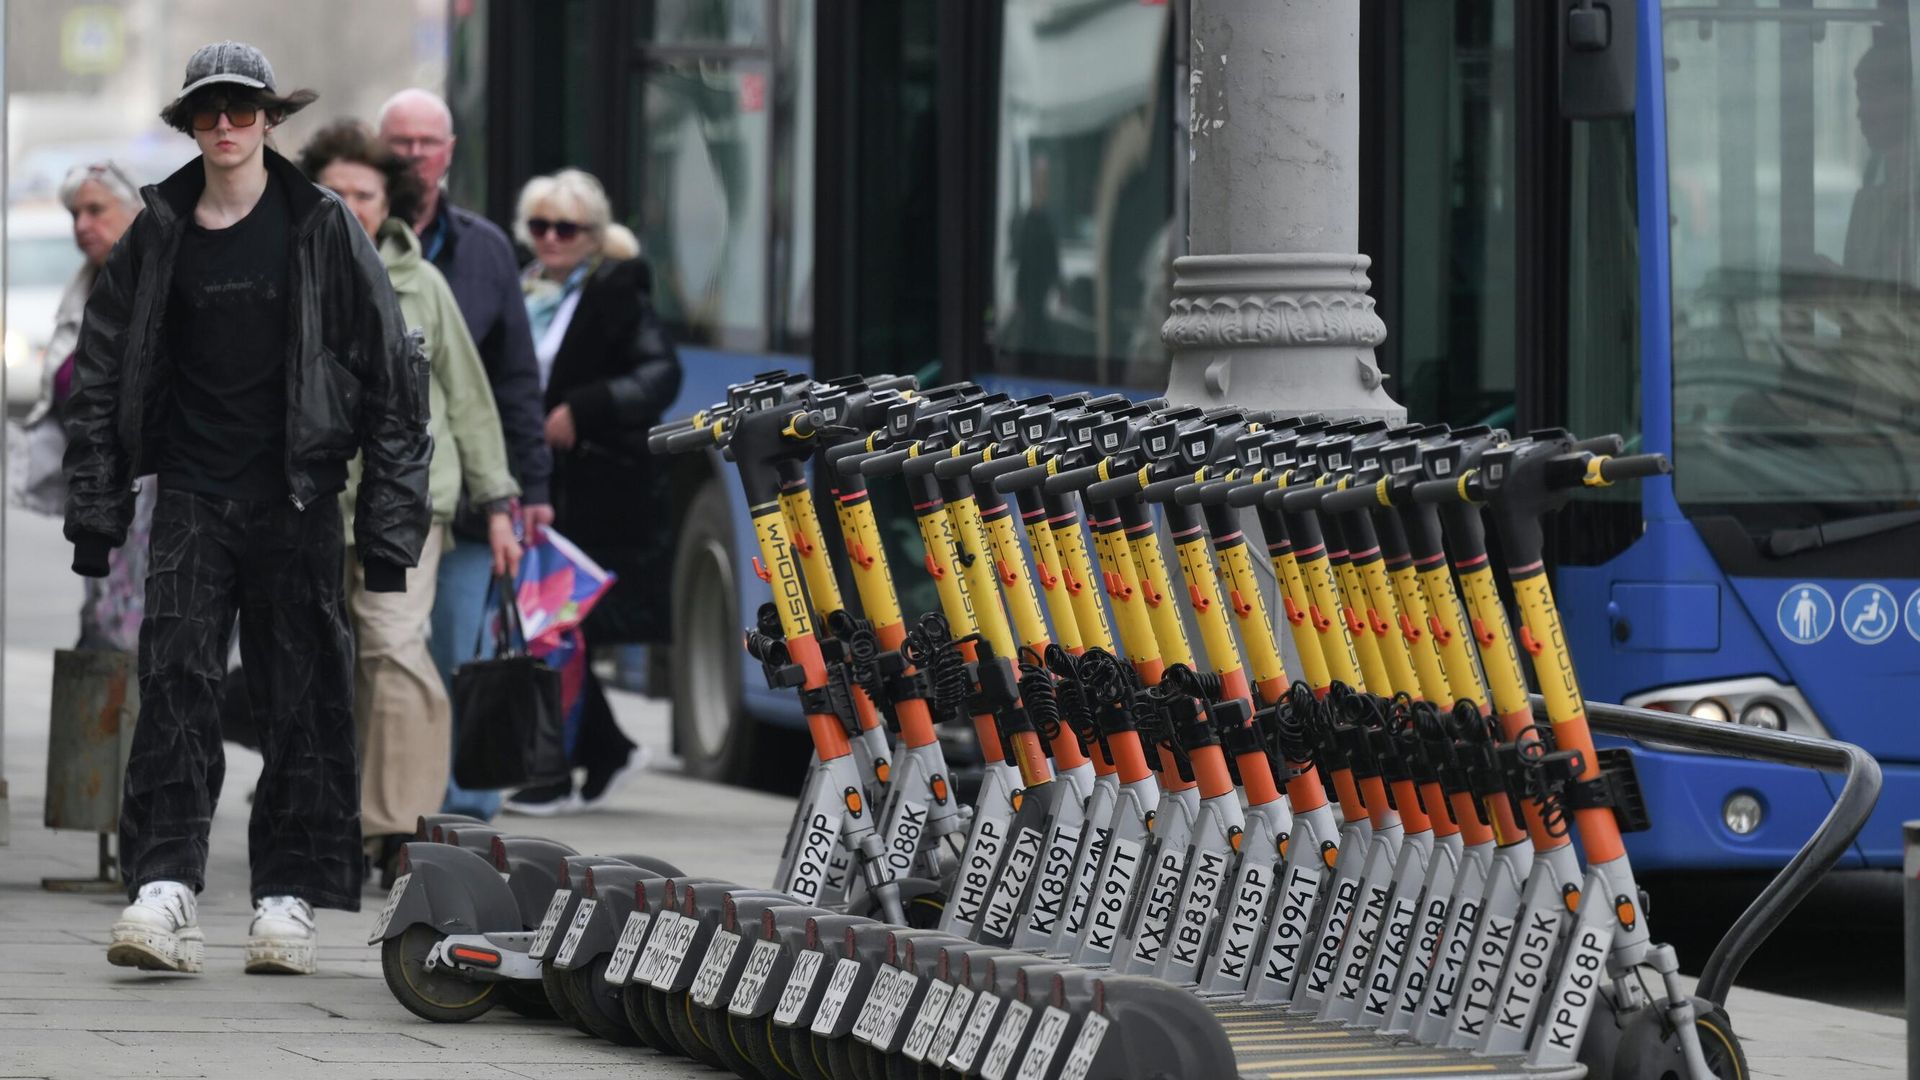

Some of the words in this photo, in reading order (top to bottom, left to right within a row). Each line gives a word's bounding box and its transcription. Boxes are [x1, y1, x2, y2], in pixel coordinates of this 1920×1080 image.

[767, 523, 810, 635] WHOOSH
[1539, 585, 1581, 713] WHOOSH
[792, 814, 834, 899] B929P
[955, 822, 1000, 923] KH893P
[985, 831, 1042, 934] KE221M
[1029, 827, 1078, 934] KK859T
[1090, 846, 1135, 949] KP697T
[621, 918, 646, 945] KK8
[668, 922, 695, 953] KP6
[1136, 854, 1184, 962] KX555P
[1174, 854, 1223, 963] KB833M
[1220, 869, 1265, 978] KK135P
[1266, 869, 1316, 982] KA994T
[610, 947, 634, 976] 59T
[655, 954, 681, 985] 97T
[733, 977, 763, 1009] 33M
[745, 946, 775, 977] KB8
[779, 985, 806, 1014] 35P
[791, 954, 820, 983] KK1
[830, 963, 857, 993] KA9
[1365, 900, 1413, 1014] KP768T
[1459, 920, 1512, 1035] KT919K
[1501, 912, 1556, 1028] KT605K
[1549, 932, 1604, 1049] KP068P
[816, 997, 842, 1028] 94T
[906, 1019, 934, 1054] 68T
[921, 986, 950, 1020] KP7
[999, 1006, 1027, 1043] KT9
[1036, 1013, 1064, 1047] KT6
